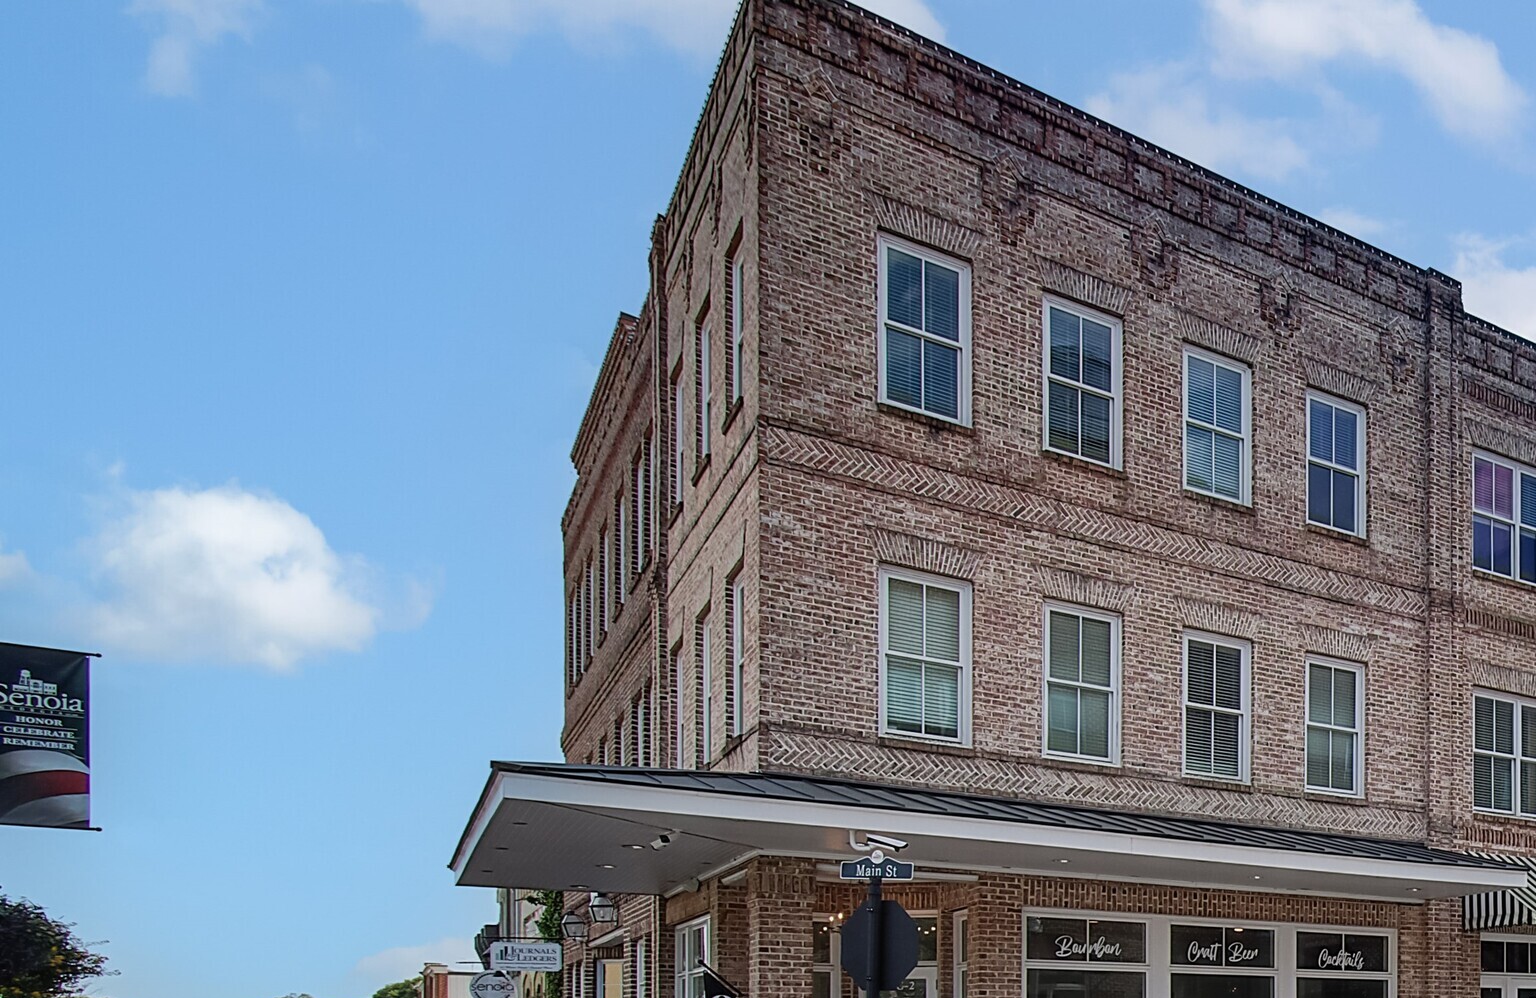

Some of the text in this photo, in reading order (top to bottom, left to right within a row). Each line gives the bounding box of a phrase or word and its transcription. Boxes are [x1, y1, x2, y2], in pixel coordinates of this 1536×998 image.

[15, 715, 63, 727] HONOR
[3, 726, 75, 739] CELEBRATE
[3, 737, 75, 750] REMEMBER
[856, 864, 898, 877] Main St
[1054, 935, 1122, 958] Bourbon
[1187, 940, 1259, 963] Craft Beer
[1318, 948, 1365, 971] Cocktails
